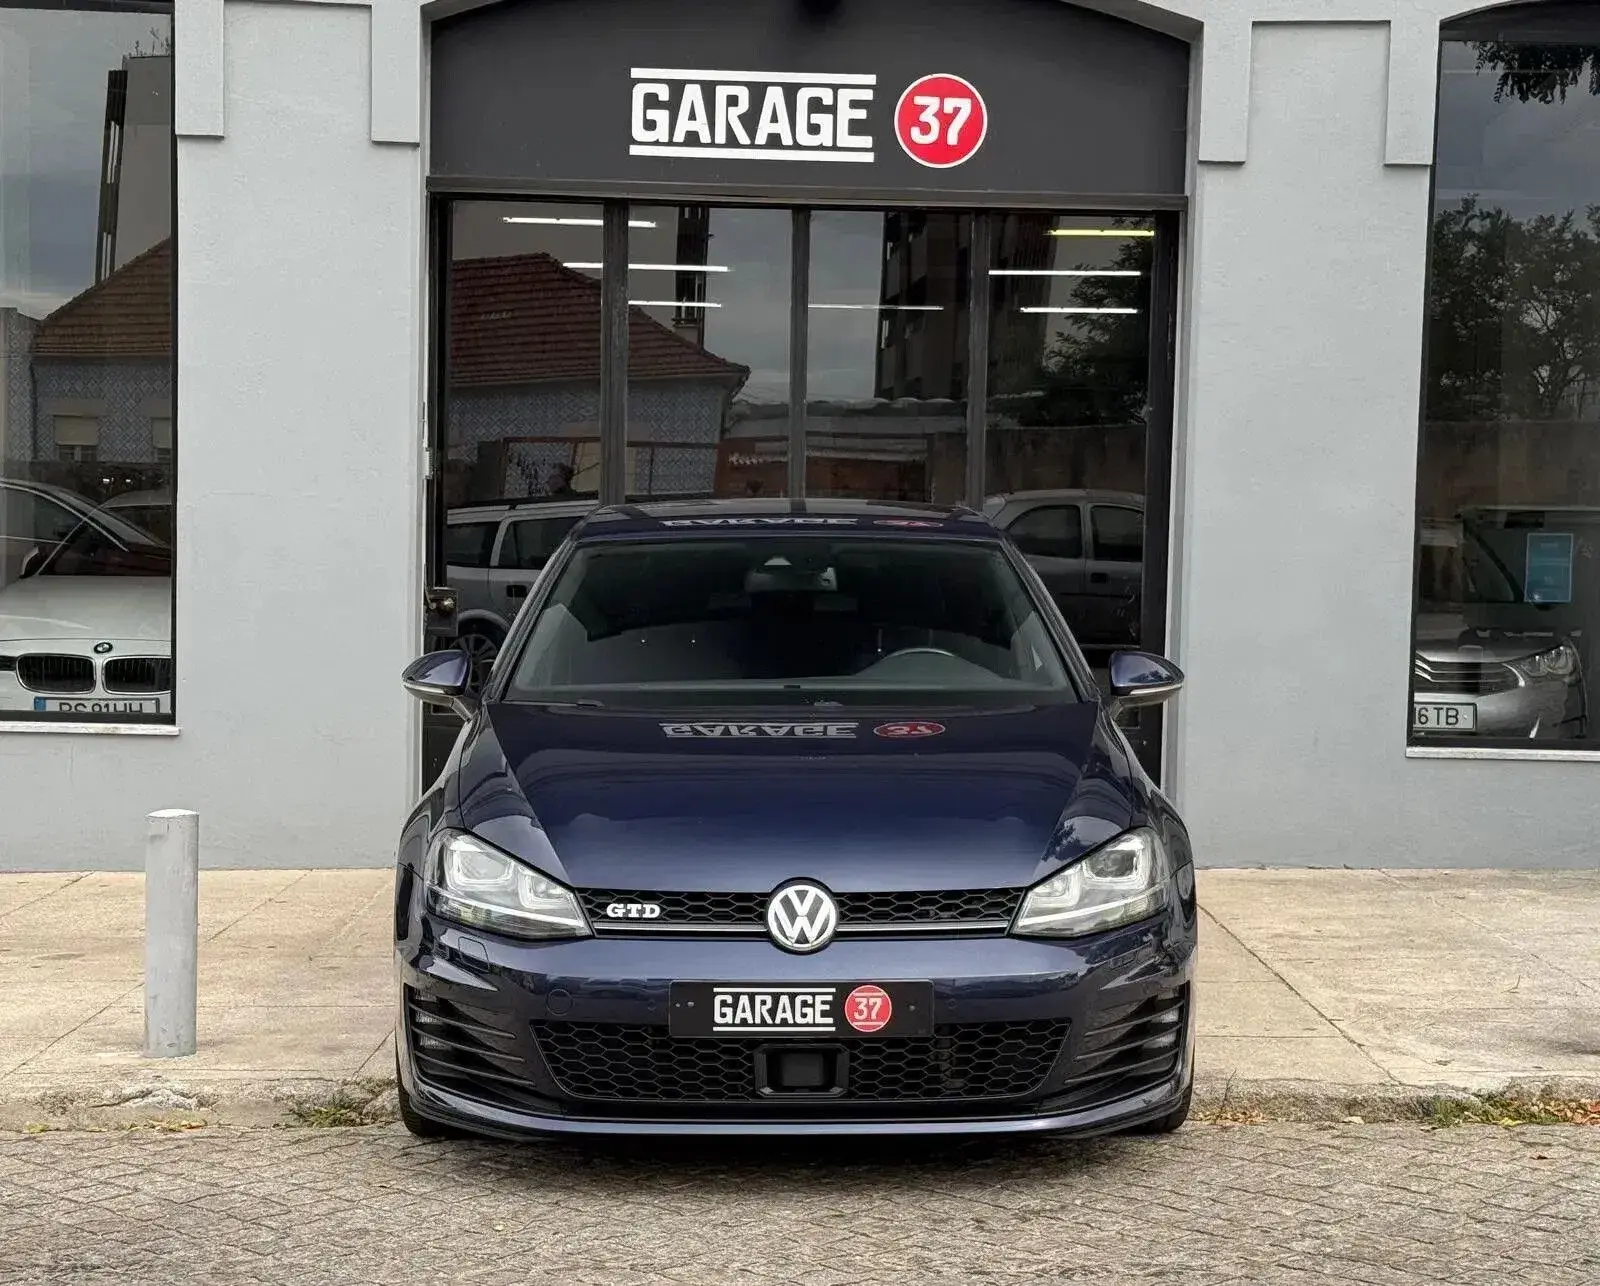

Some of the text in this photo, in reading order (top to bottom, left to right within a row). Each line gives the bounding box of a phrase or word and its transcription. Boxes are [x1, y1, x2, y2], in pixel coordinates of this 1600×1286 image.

[631, 82, 972, 148] GARAGE 37
[606, 903, 661, 918] GTD
[713, 994, 882, 1024] GARAGE 37
